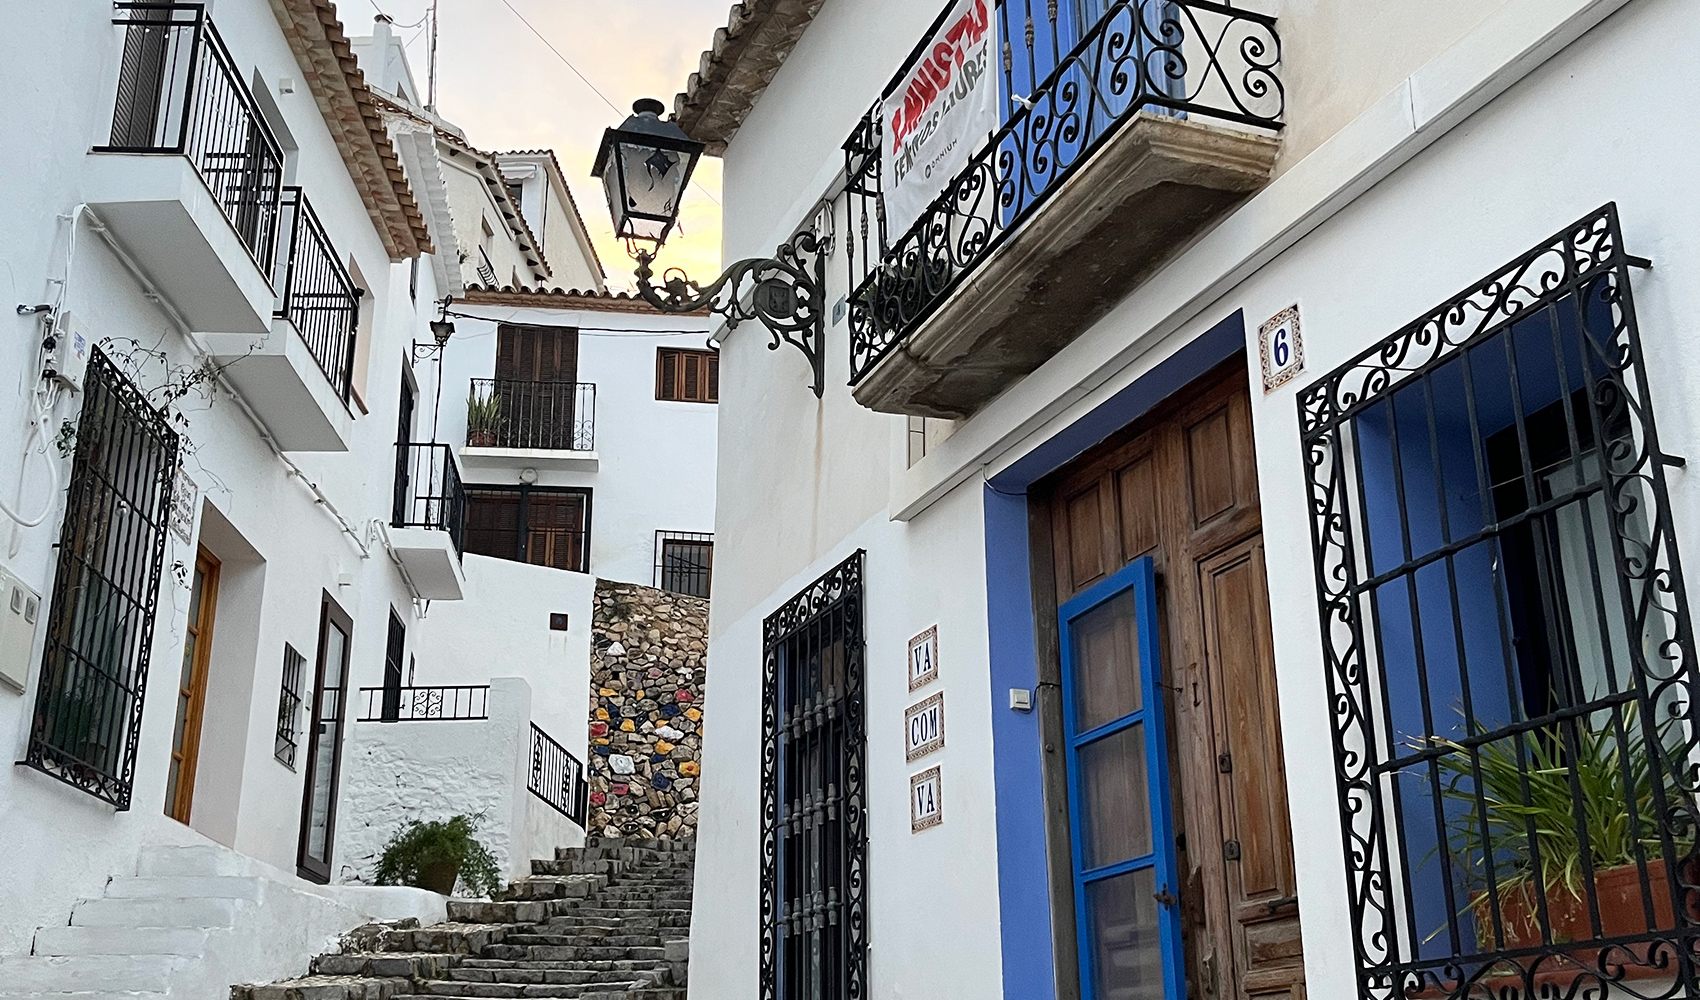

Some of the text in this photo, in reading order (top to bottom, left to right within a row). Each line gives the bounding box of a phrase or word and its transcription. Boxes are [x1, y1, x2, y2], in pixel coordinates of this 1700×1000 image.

[1273, 328, 1288, 367] 6
[914, 642, 931, 675] VA
[911, 707, 937, 746] COM
[916, 782, 935, 816] VA
